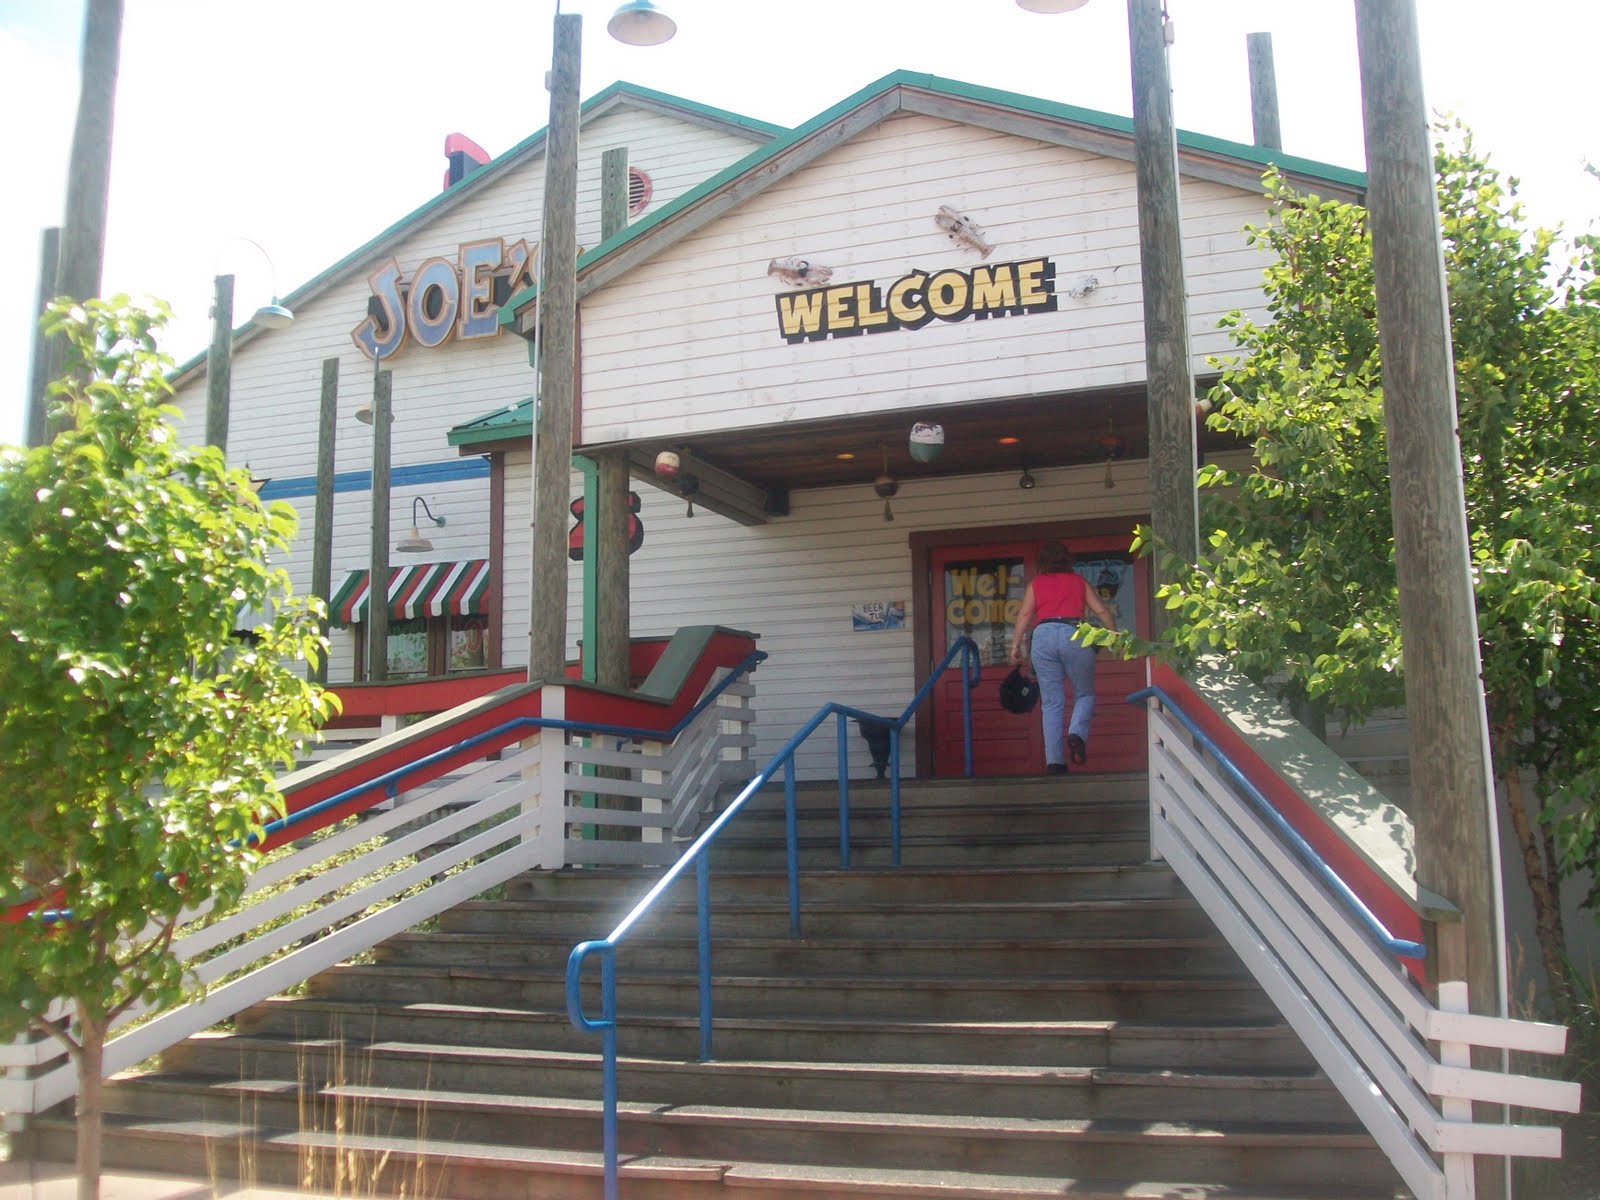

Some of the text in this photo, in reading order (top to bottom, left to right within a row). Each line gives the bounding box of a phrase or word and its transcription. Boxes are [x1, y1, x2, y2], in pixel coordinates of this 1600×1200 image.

[350, 236, 545, 361] JOE'
[776, 257, 1057, 344] WELCOME
[863, 603, 884, 613] BEER
